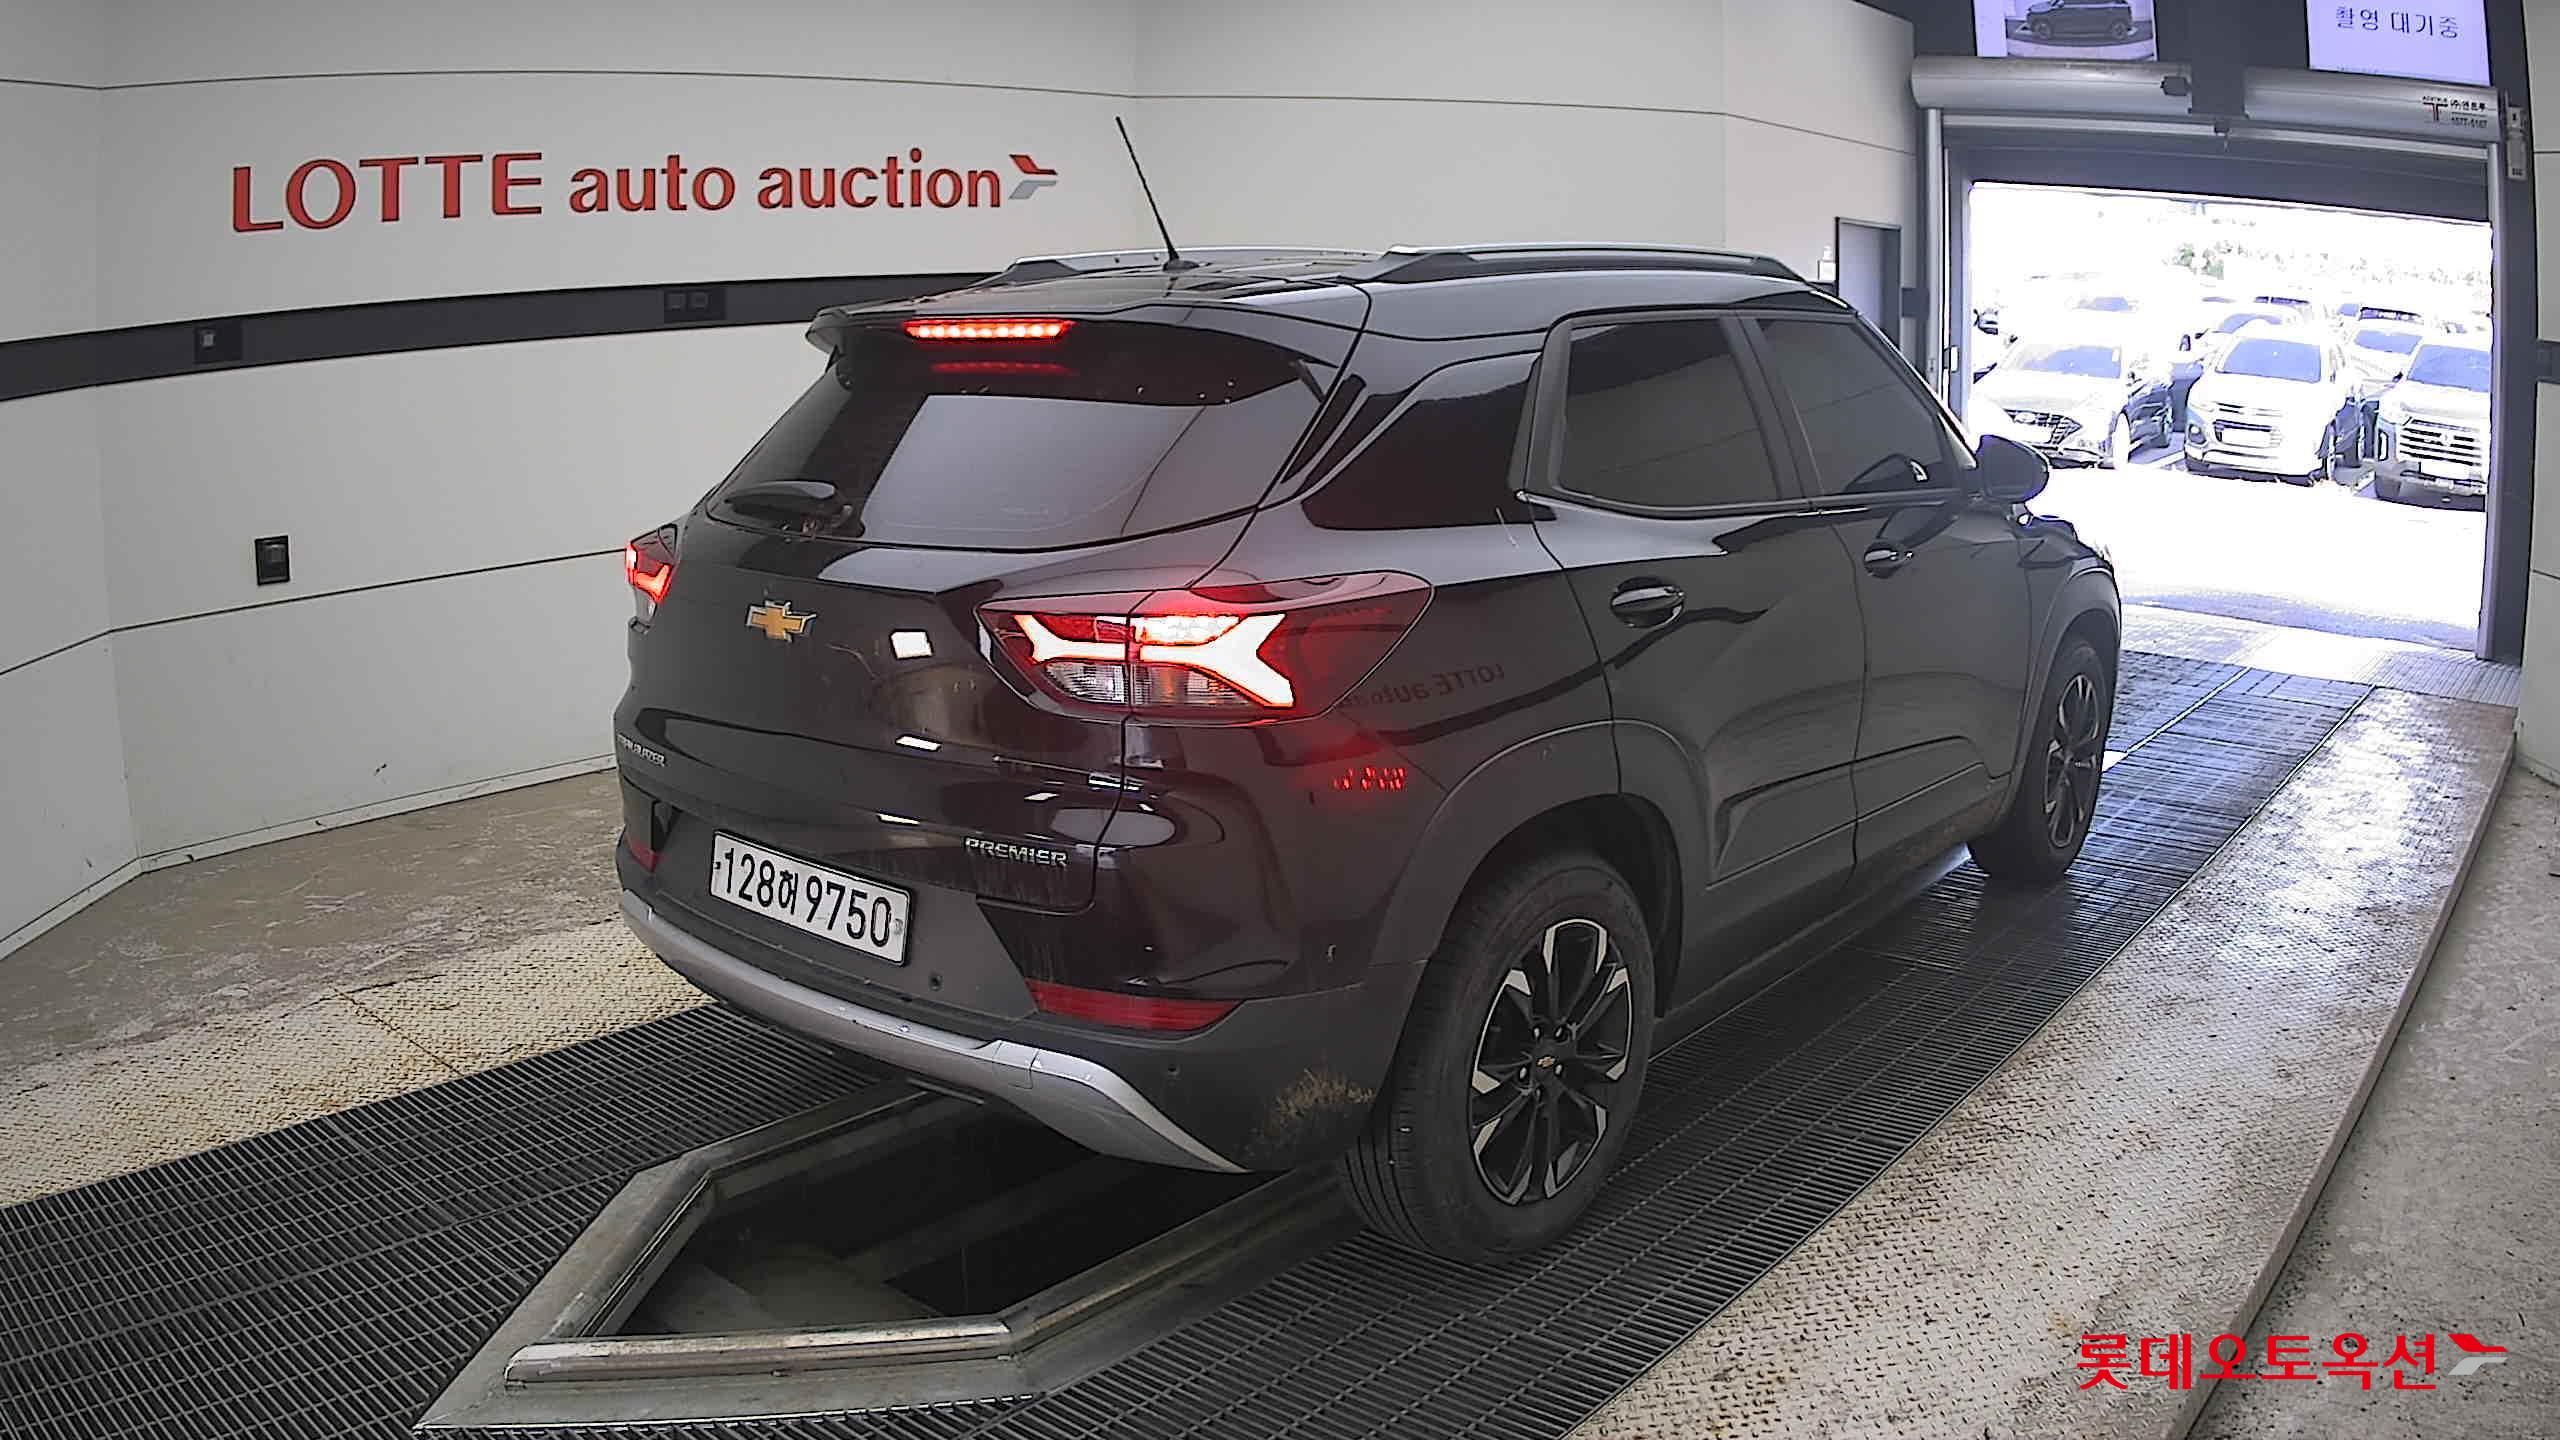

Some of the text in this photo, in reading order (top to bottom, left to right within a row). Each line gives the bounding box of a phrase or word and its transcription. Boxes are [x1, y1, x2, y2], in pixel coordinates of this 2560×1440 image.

[2336, 6, 2458, 39] 촬영 대기중
[232, 147, 1001, 233] LOTTE auto auction
[964, 836, 1068, 868] PREMIER
